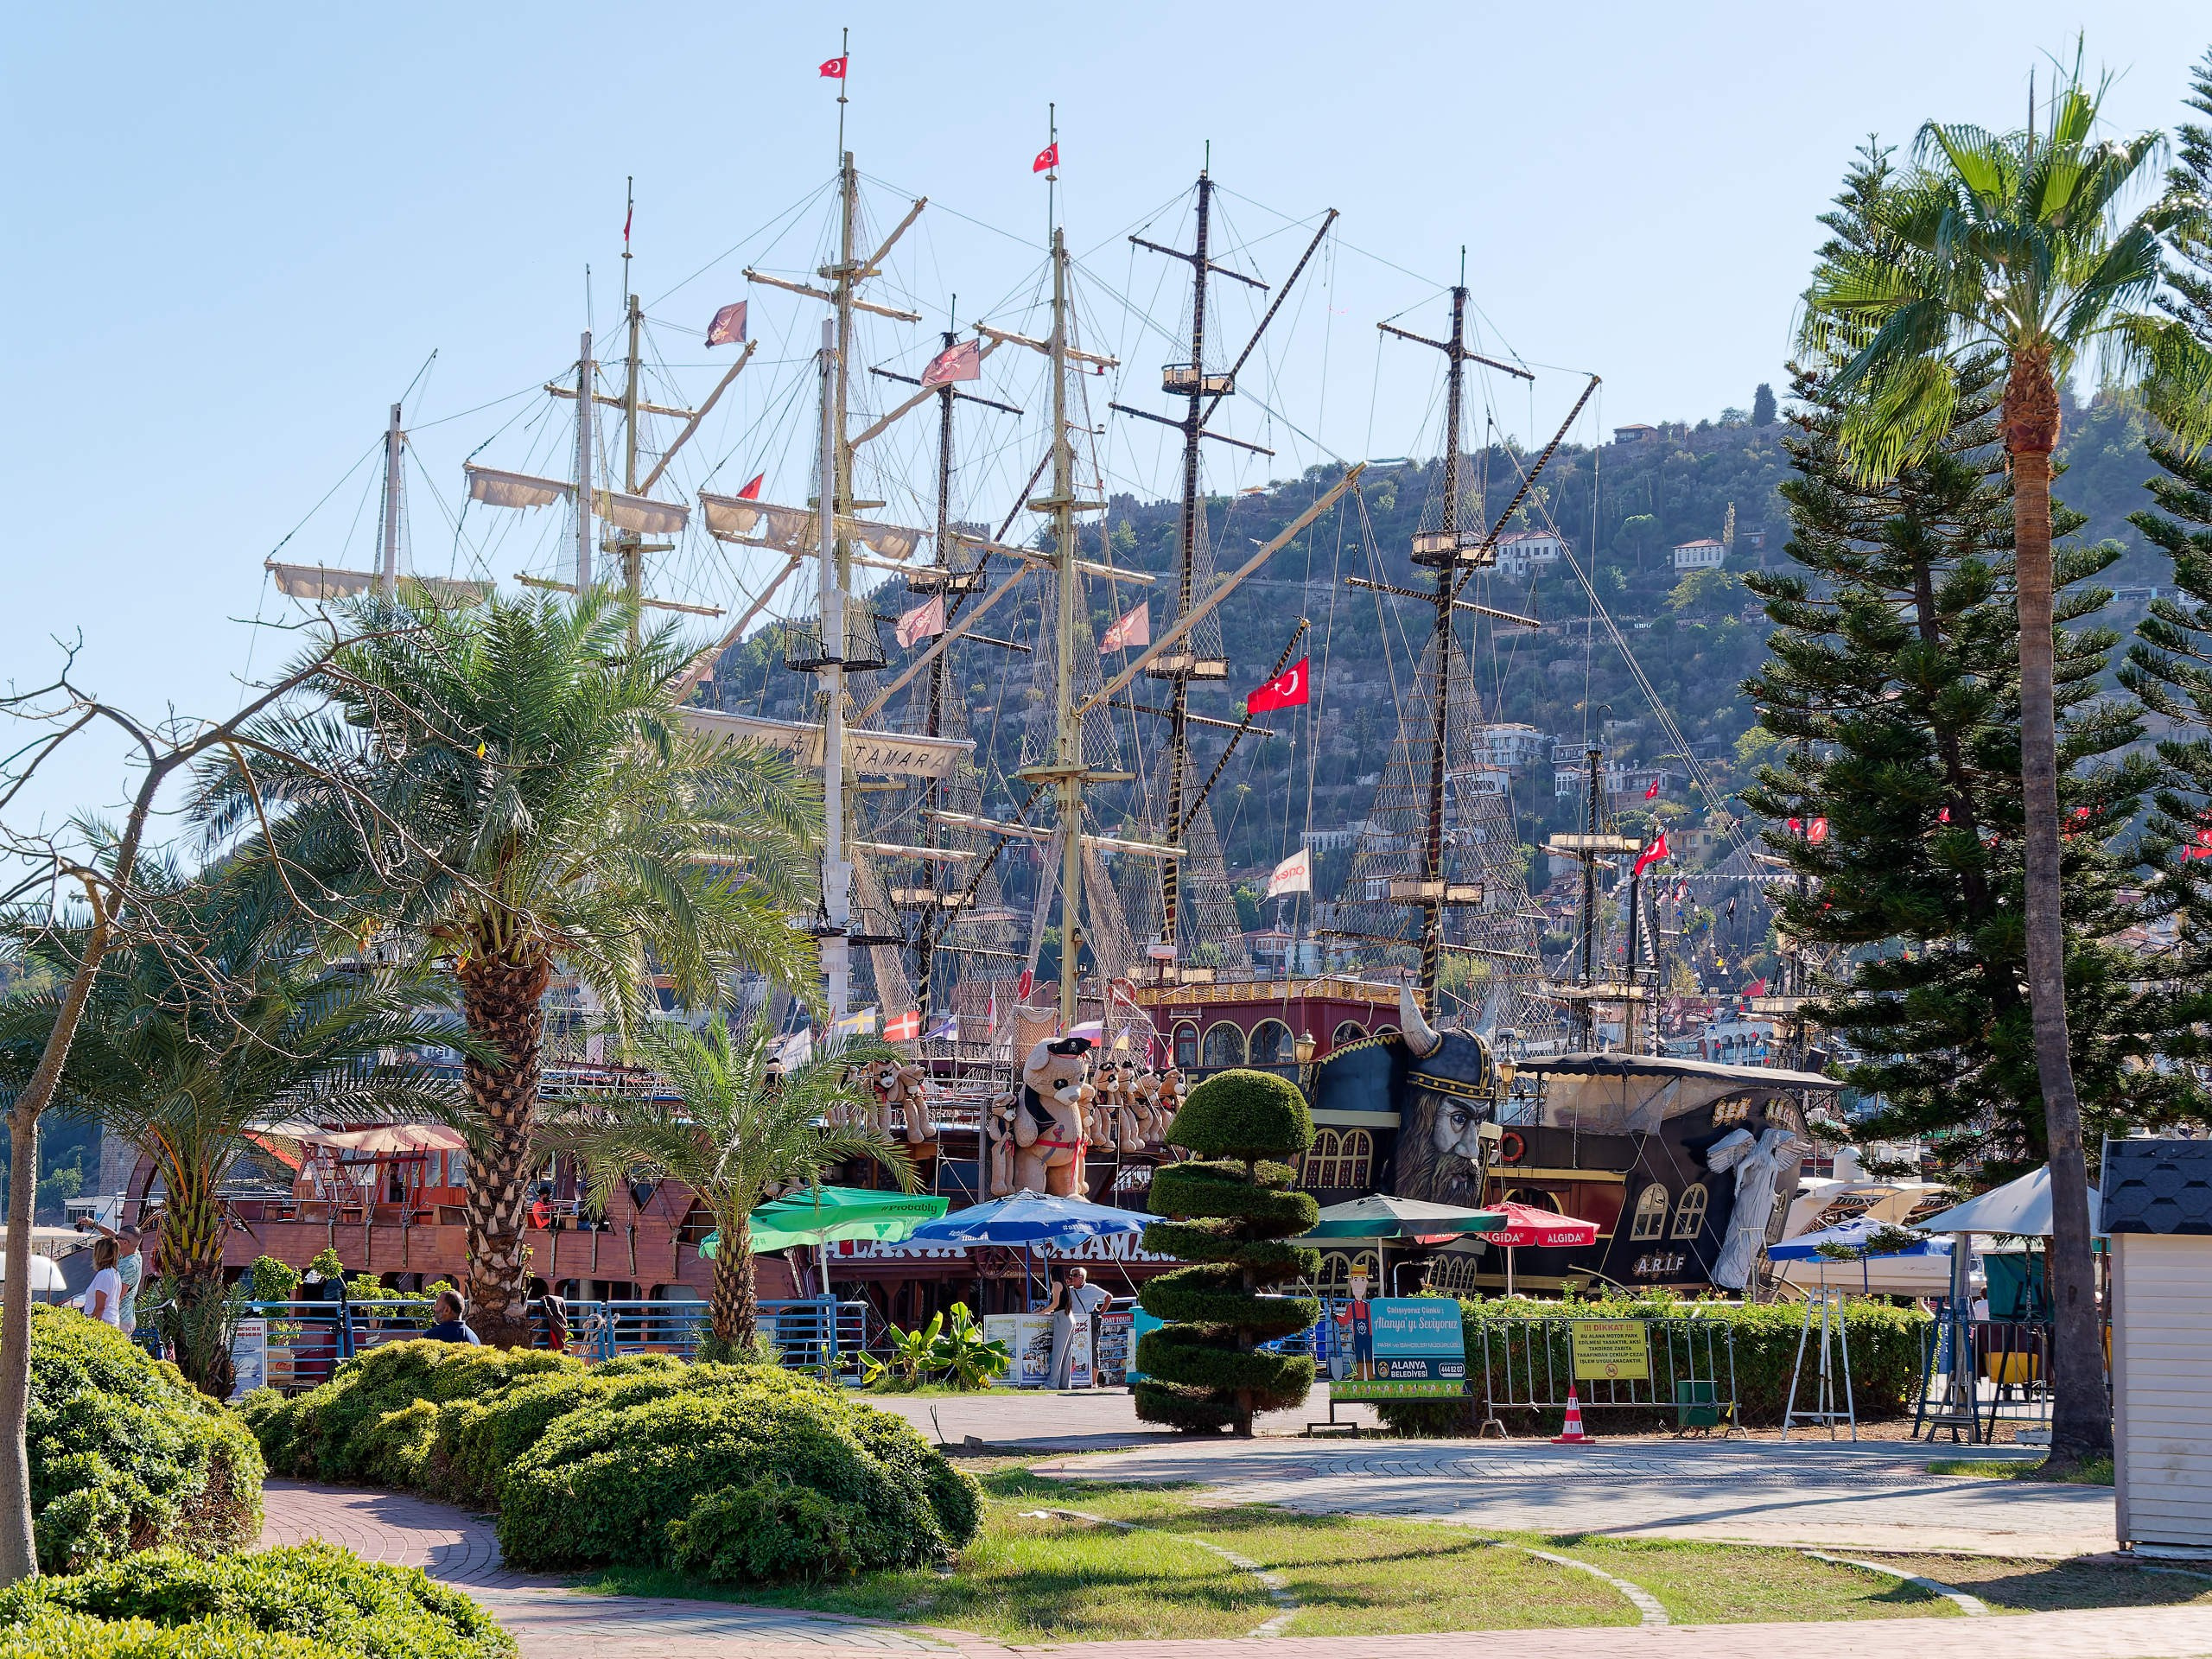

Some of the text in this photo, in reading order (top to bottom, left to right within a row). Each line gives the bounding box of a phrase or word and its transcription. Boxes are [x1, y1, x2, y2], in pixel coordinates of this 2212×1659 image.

[1418, 1316, 1458, 1332] Seviyoruz
[1391, 1361, 1427, 1370] ALANYA
[1391, 1369, 1428, 1378] BELEDİYESİ
